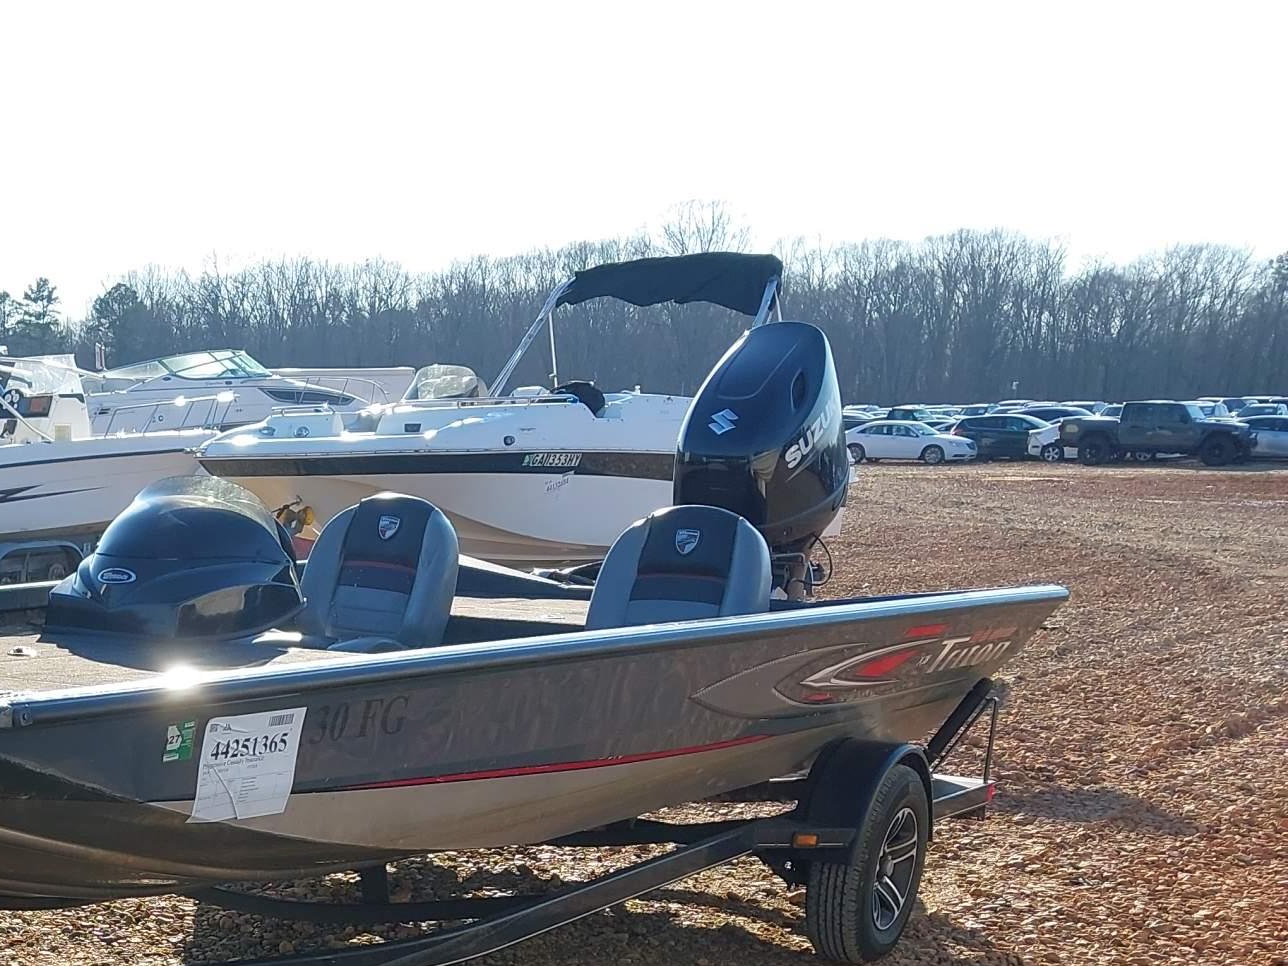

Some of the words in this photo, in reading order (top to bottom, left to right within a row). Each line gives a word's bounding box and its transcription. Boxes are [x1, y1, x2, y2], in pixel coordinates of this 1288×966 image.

[355, 695, 409, 738] FG
[168, 735, 181, 745] 27
[211, 732, 289, 760] 44251365
